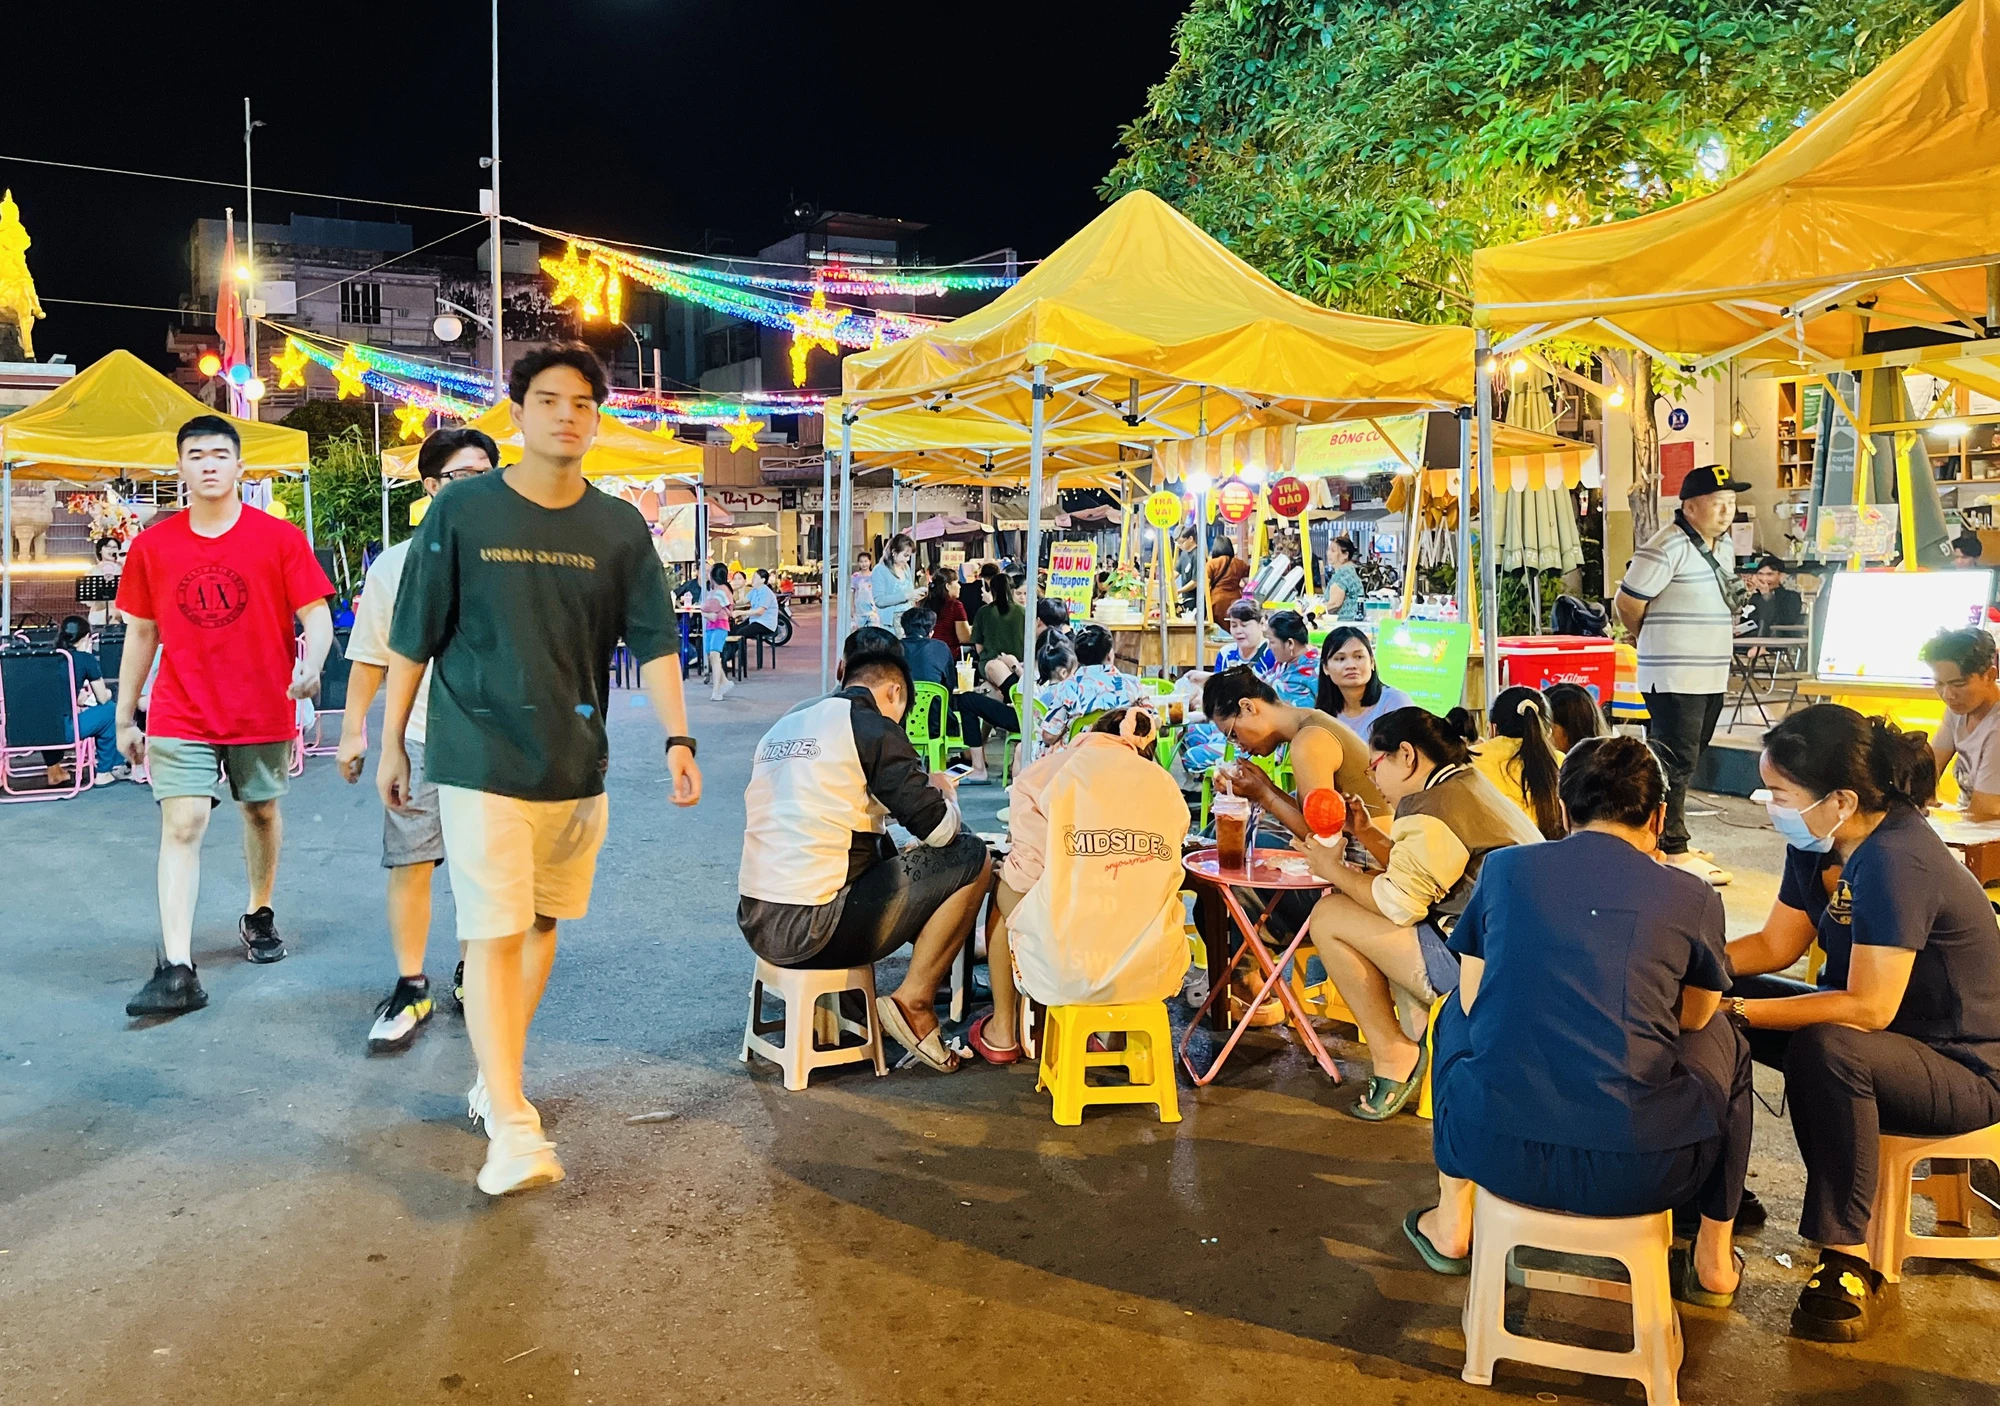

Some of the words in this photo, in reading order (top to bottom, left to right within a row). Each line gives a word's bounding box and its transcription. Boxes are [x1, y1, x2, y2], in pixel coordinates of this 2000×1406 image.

[1329, 430, 1365, 446] BÔNG
[1711, 465, 1730, 487] P
[1050, 572, 1090, 588] Singapore
[1065, 829, 1163, 857] MIDSIDE
